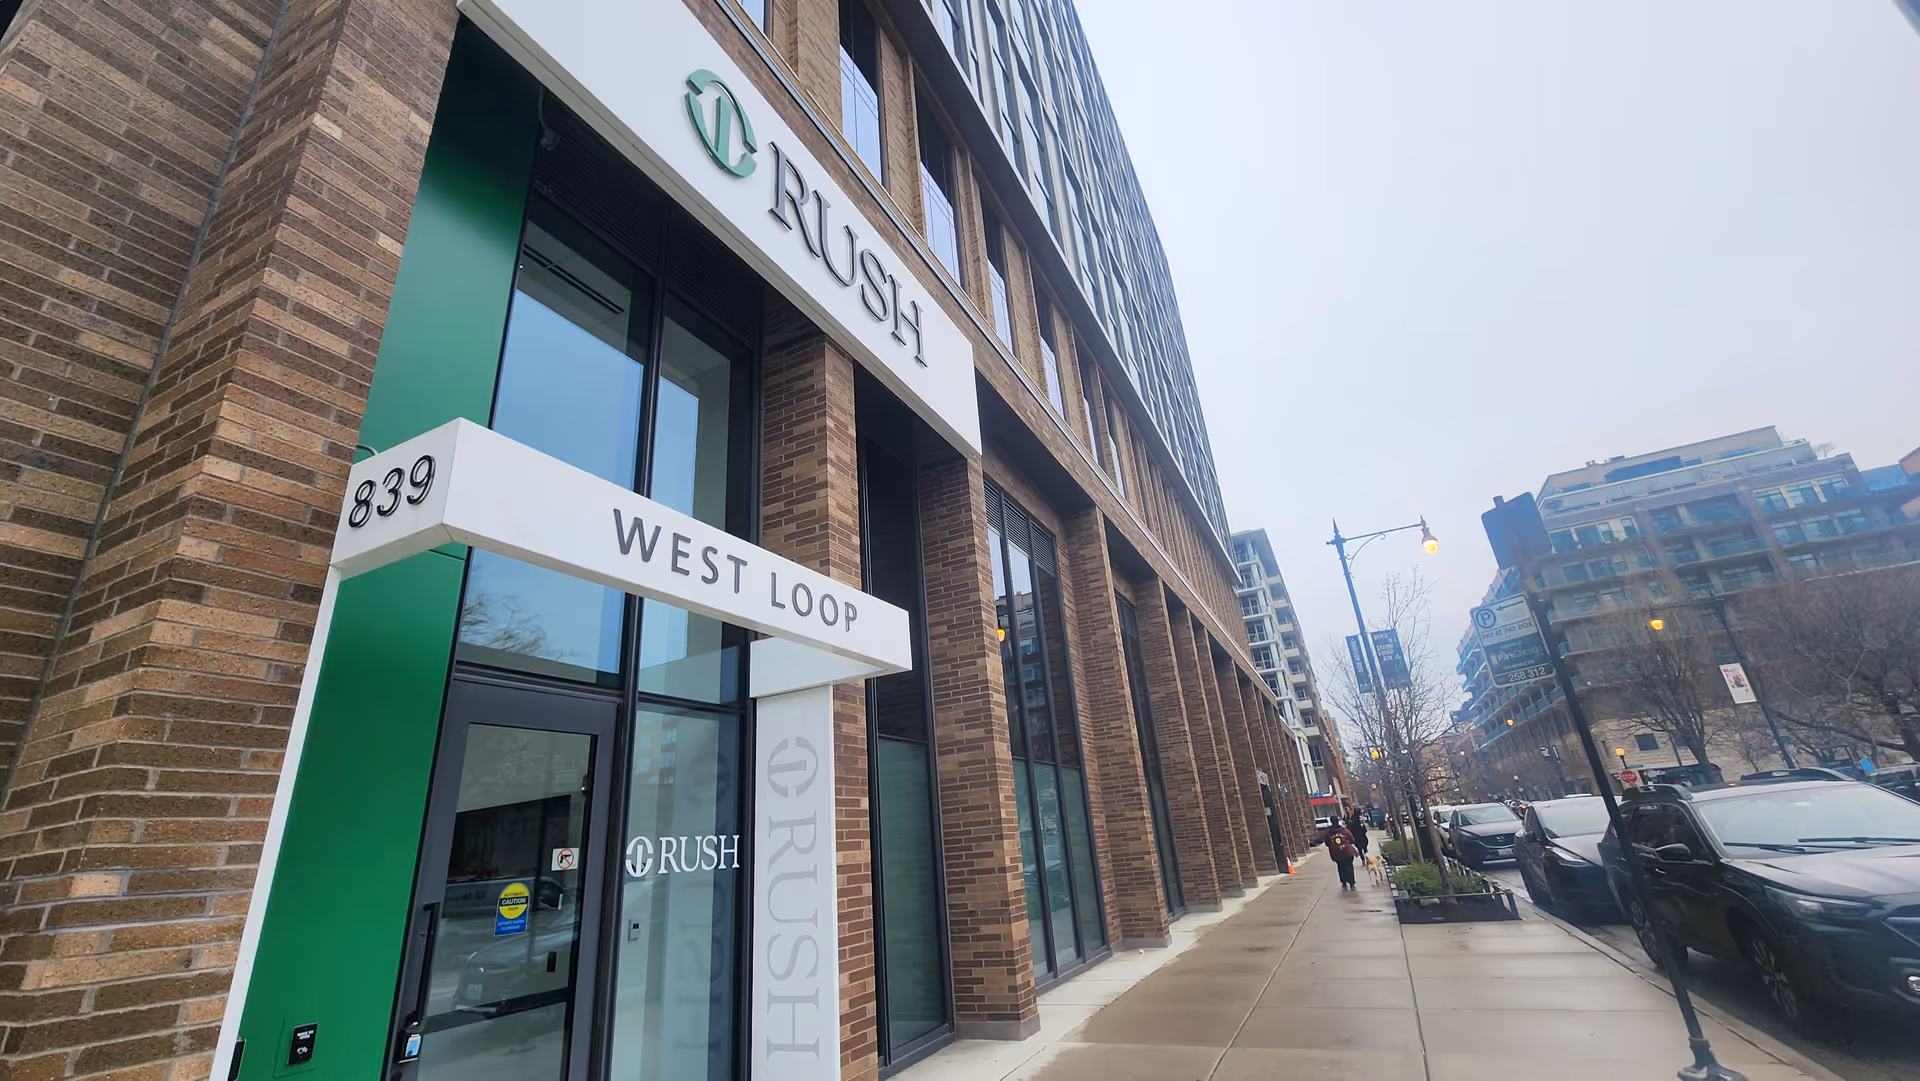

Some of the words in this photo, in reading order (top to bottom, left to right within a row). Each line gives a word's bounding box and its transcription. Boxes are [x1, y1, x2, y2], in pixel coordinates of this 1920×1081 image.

[767, 141, 928, 368] RUSH
[347, 454, 436, 529] 839
[612, 508, 748, 594] WEST
[770, 571, 859, 633] LOOP
[1504, 625, 1517, 635] PAY
[1528, 666, 1547, 677] 312
[657, 834, 740, 874] RUSH
[501, 897, 526, 905] CAUTION
[766, 810, 820, 1060] RUSH
